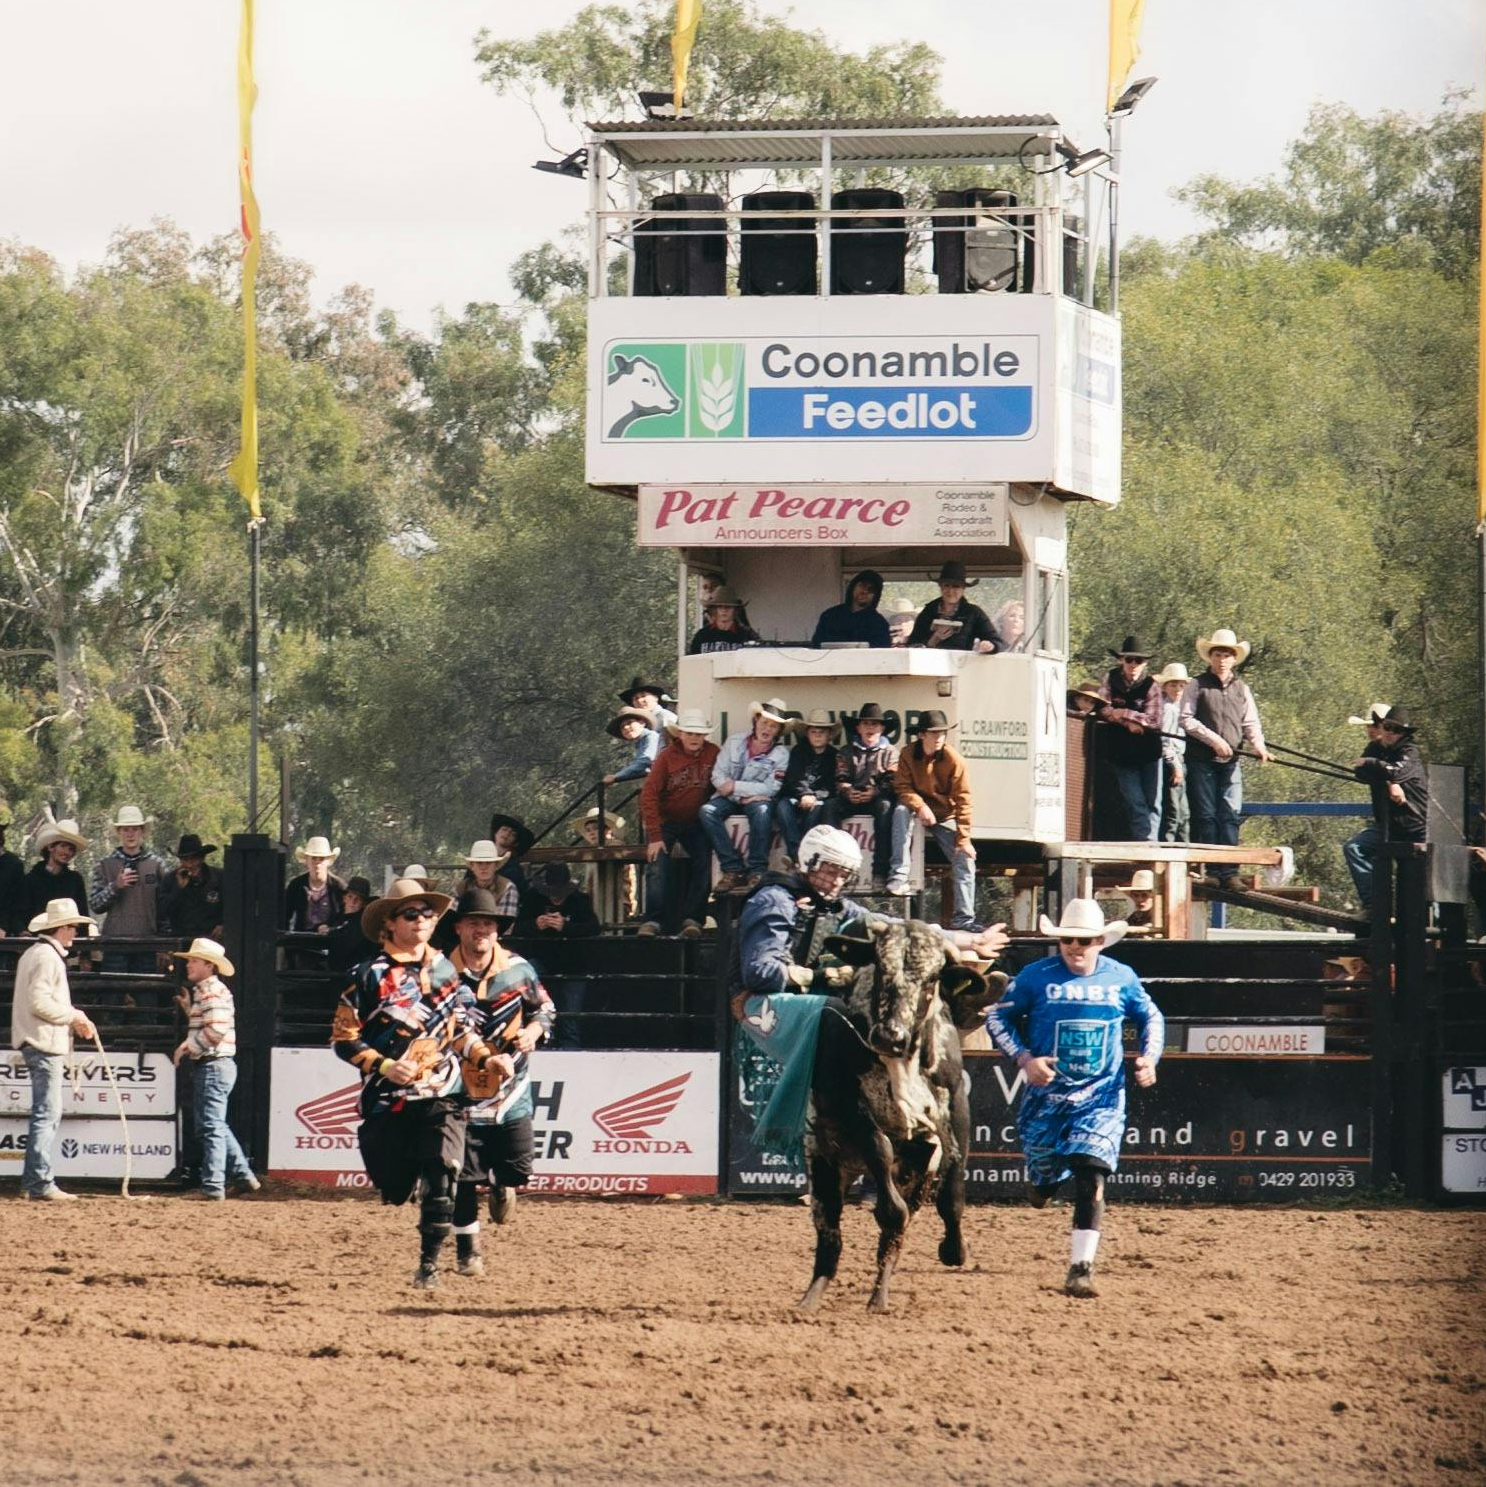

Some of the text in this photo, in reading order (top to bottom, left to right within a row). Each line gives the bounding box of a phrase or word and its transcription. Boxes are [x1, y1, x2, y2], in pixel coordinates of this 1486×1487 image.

[761, 343, 1020, 379] Coonamble
[802, 393, 977, 430] Feedlot
[935, 490, 995, 500] Coonamble
[655, 489, 911, 530] Pat Pearce
[942, 502, 988, 512] Rodeo &
[714, 525, 849, 540] Announcers Box
[934, 528, 997, 538] Association
[973, 719, 1028, 737] CRAWFORD
[1060, 1031, 1104, 1047] NSW
[1205, 1034, 1308, 1052] COONAMBLE
[1455, 1072, 1473, 1090] A
[1229, 1123, 1355, 1154] gravel
[82, 1143, 110, 1155] NEW
[593, 1140, 693, 1155] HONDA
[552, 1176, 649, 1192] PRODUCTS
[739, 1171, 807, 1188] www.p
[1168, 1170, 1217, 1189] Ridge
[1299, 1172, 1355, 1190] 201933
